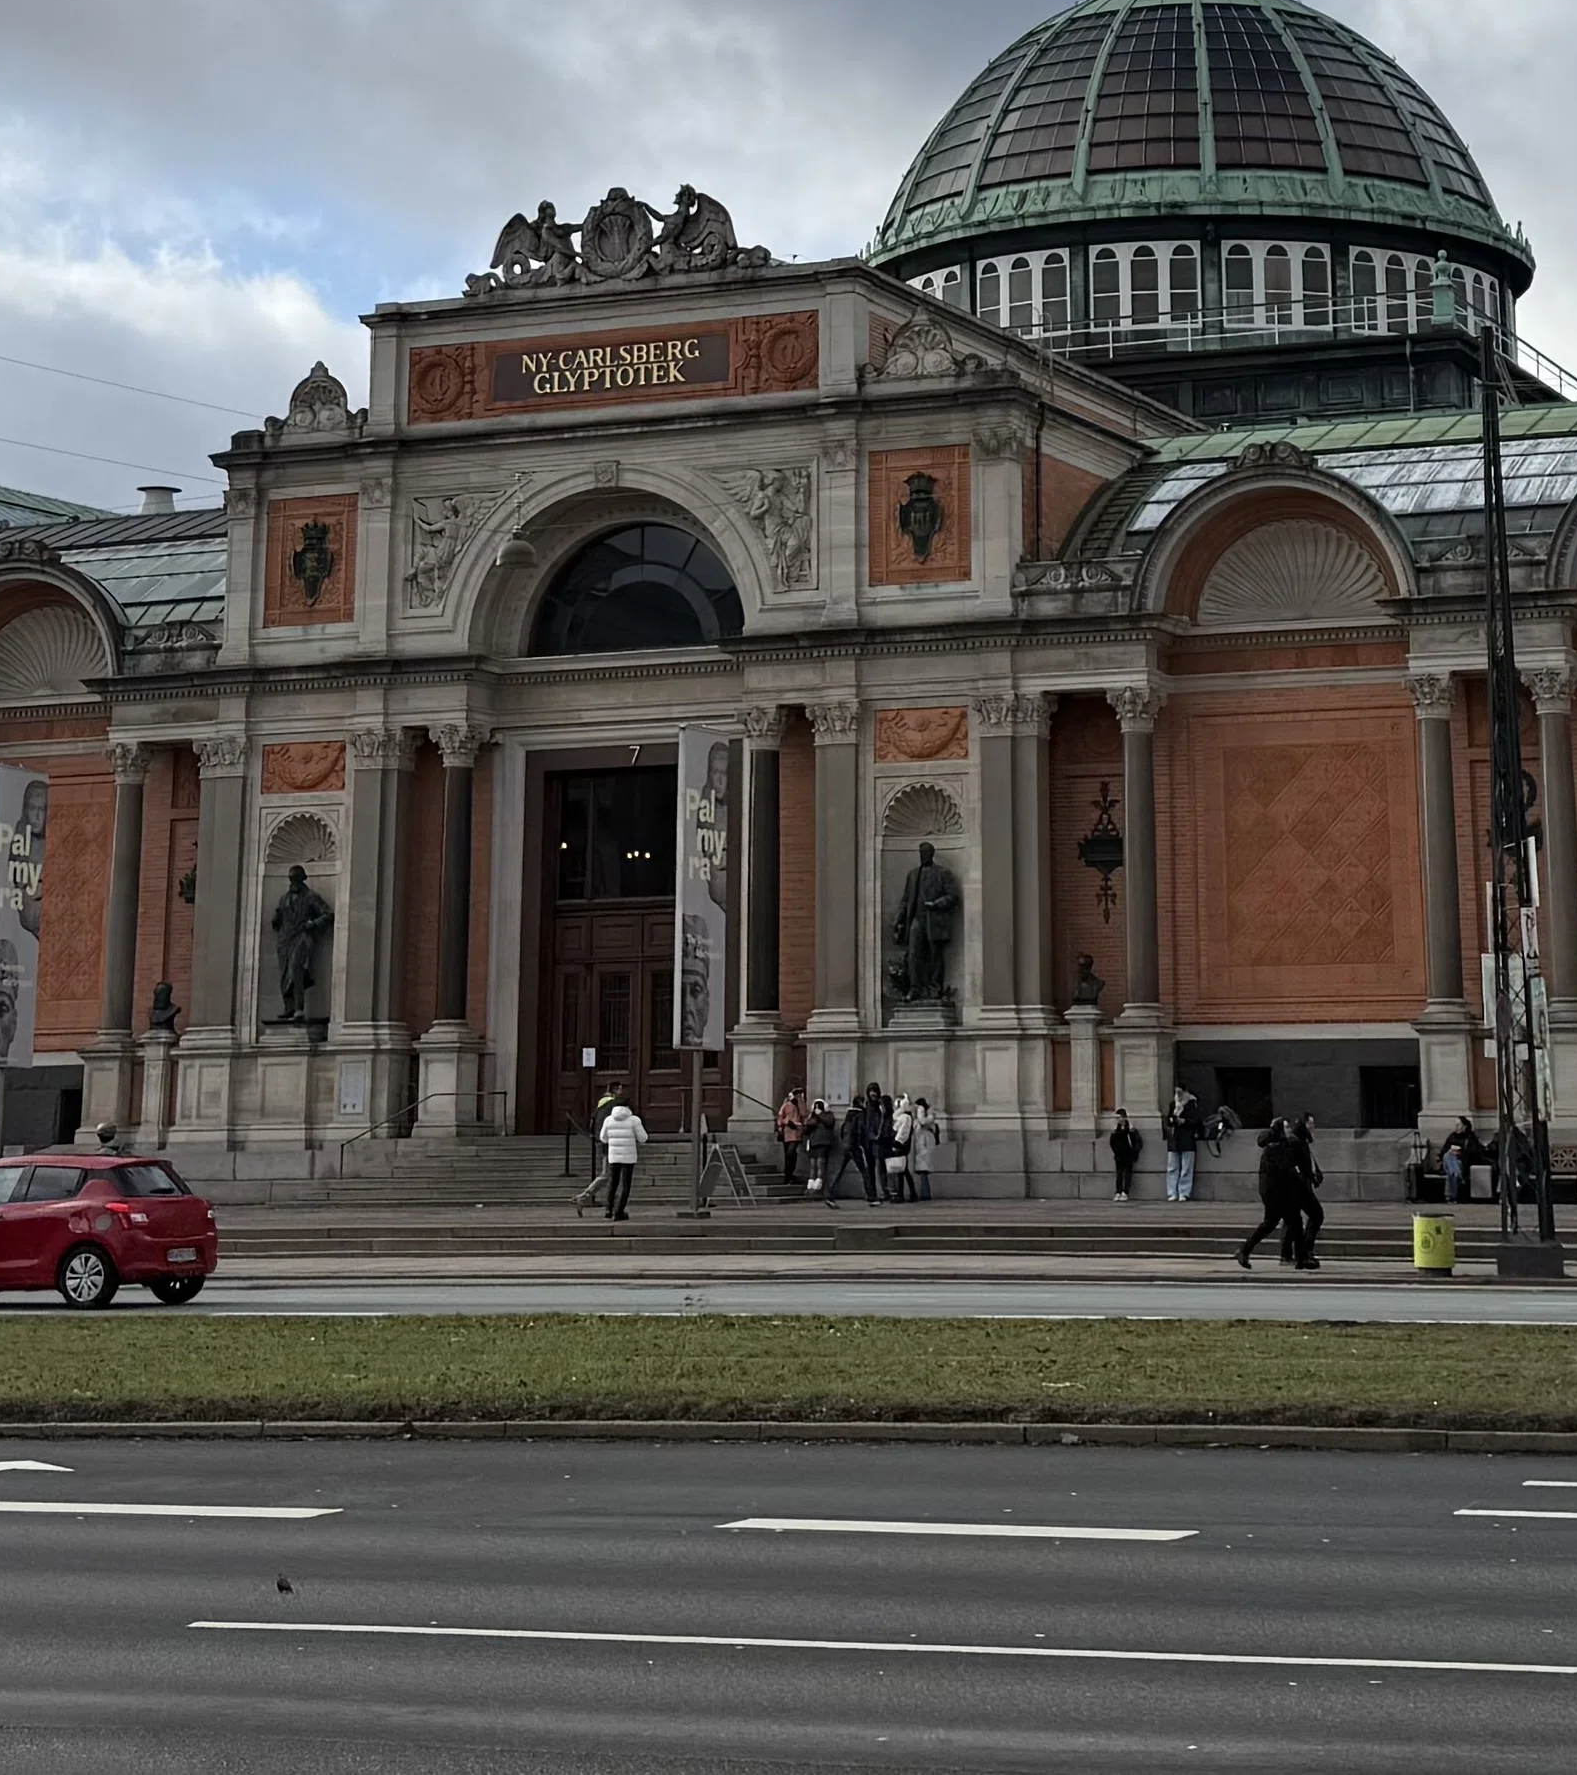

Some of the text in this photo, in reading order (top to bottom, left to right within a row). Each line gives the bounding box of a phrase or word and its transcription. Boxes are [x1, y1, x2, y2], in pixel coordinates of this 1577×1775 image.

[521, 339, 700, 374] NY-CARLSBERG
[533, 361, 686, 394] GLYPTOTEK
[628, 745, 641, 766] 7
[686, 788, 716, 823] Pal
[697, 828, 727, 866] my
[8, 861, 43, 896] my
[688, 856, 711, 881] ra
